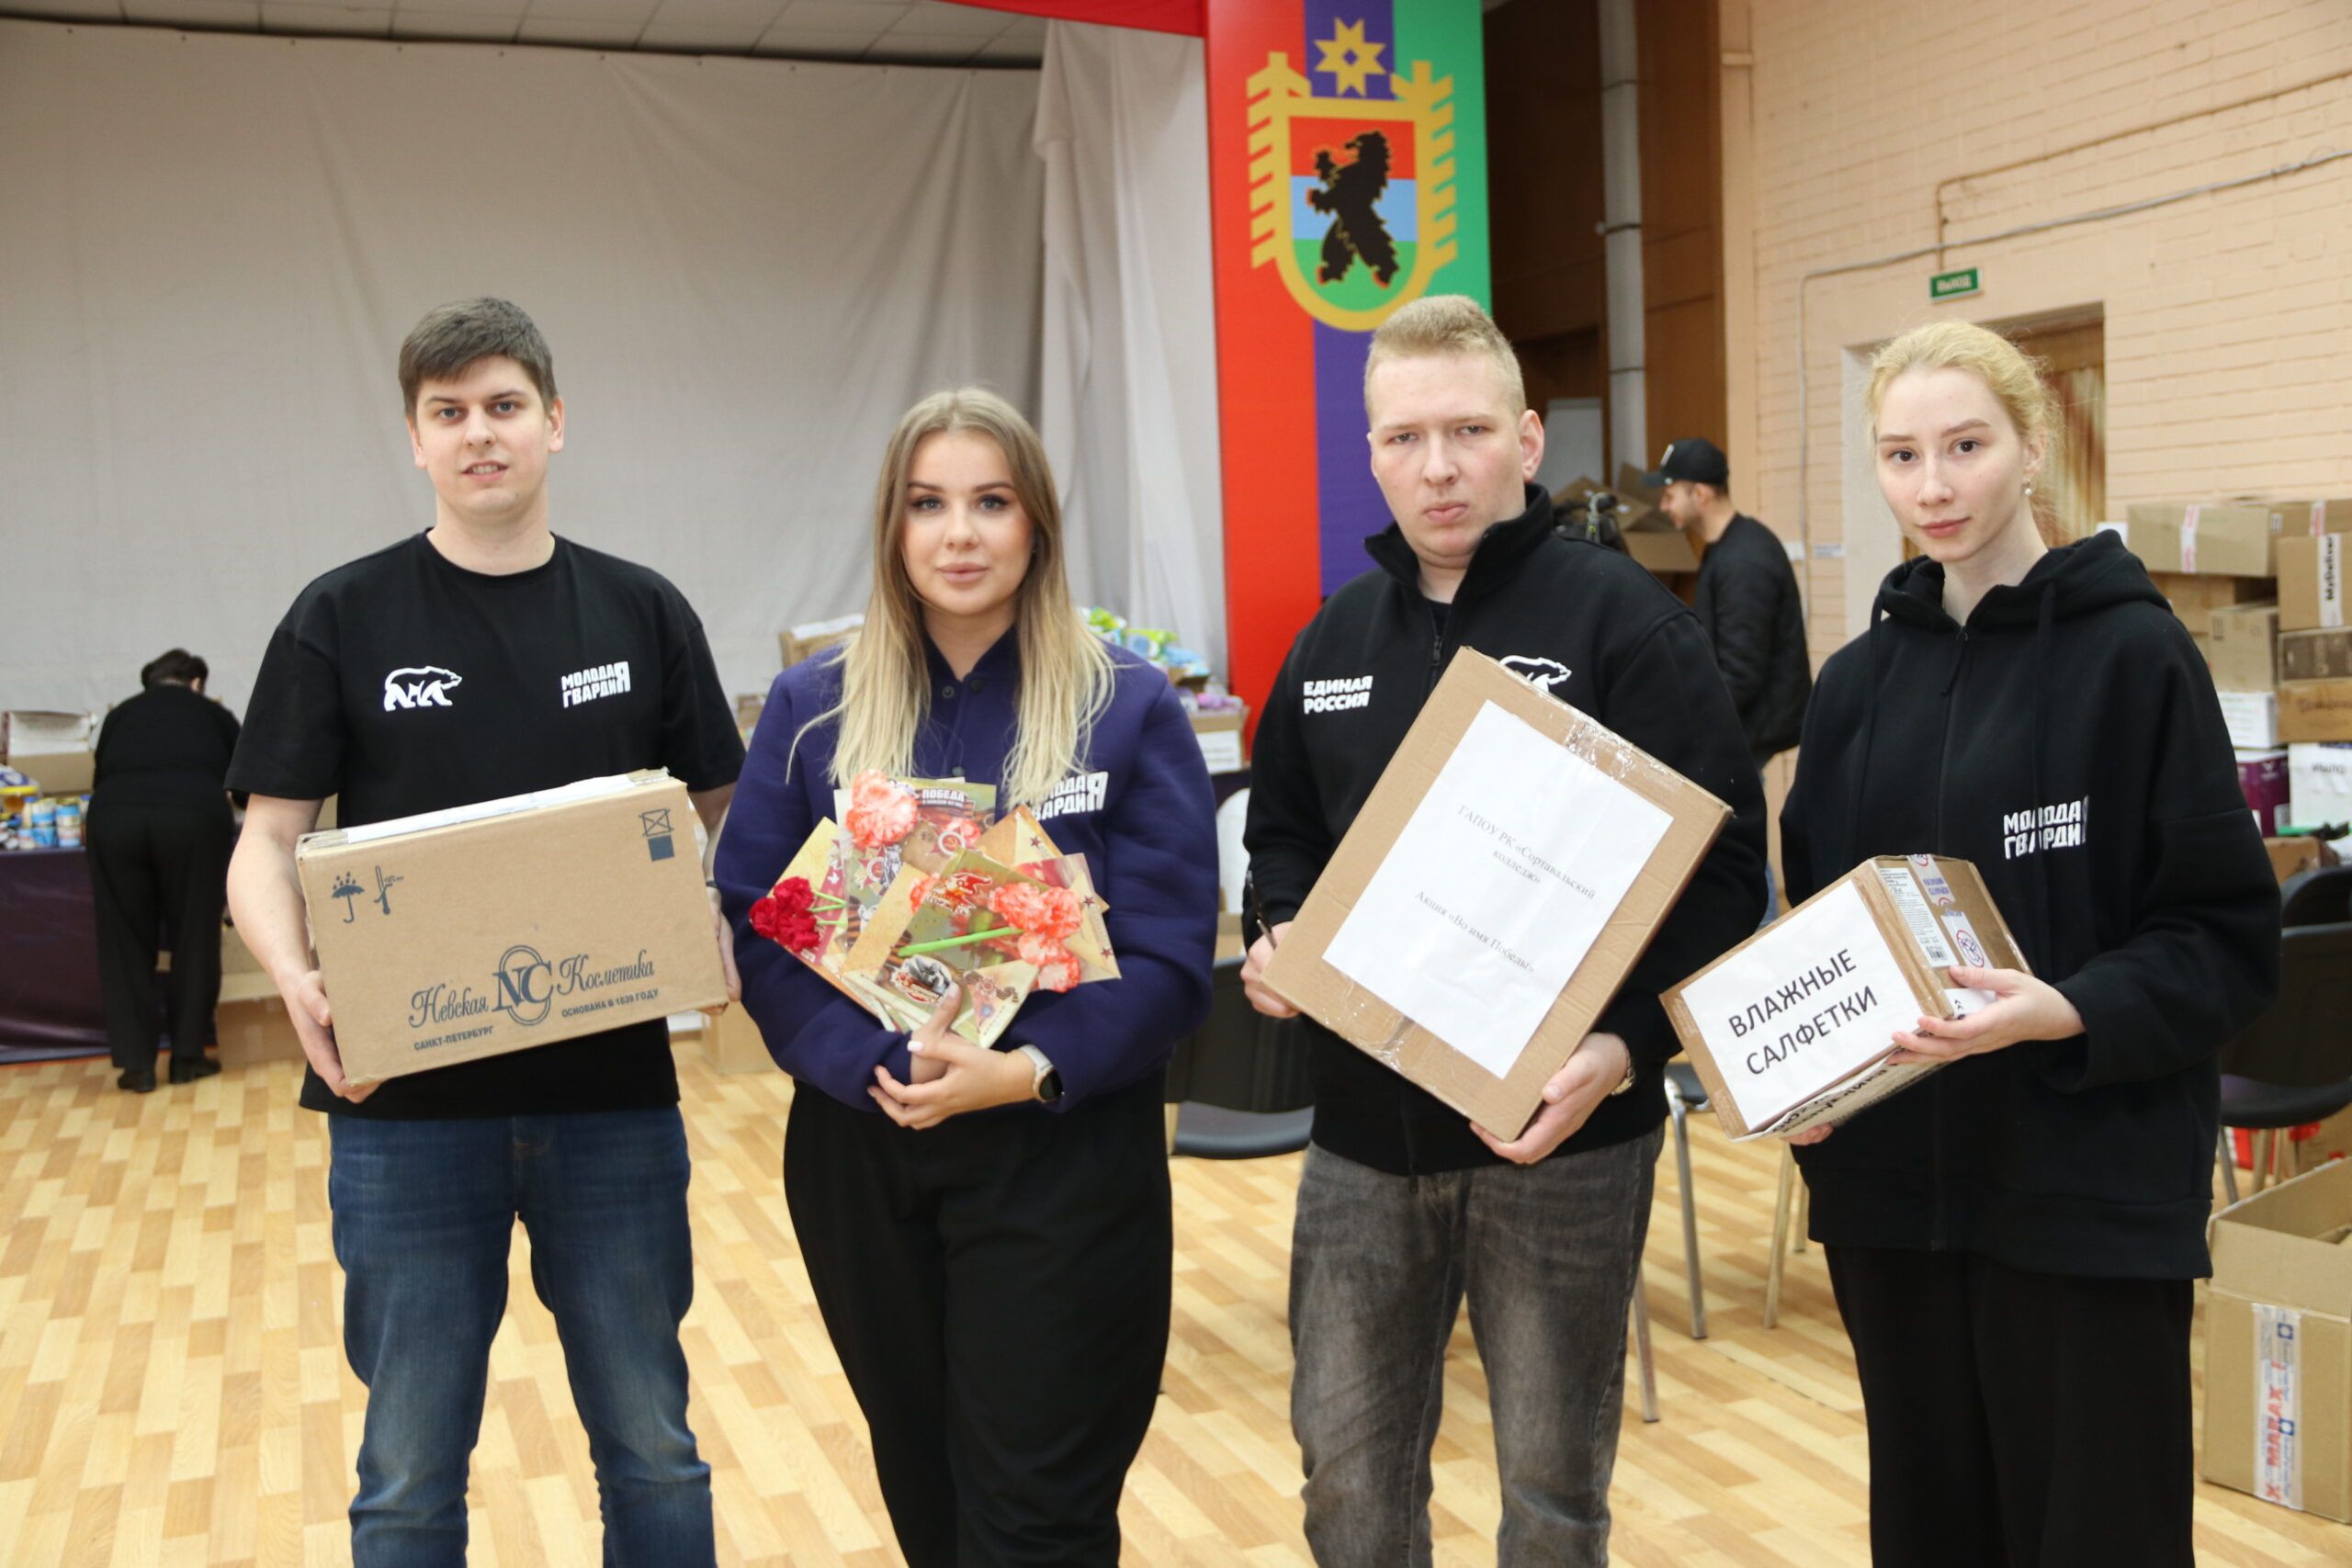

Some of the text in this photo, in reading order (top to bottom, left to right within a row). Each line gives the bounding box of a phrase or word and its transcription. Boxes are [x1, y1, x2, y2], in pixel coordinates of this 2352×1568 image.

[560, 660, 631, 692] МОЛОДАЯ
[562, 671, 631, 708] ГВАРДИЯ
[1303, 675, 1374, 697] ЕДИНАЯ
[1303, 691, 1370, 715] РОССИЯ
[922, 788, 966, 803] ПОБЕДА
[1457, 805, 1499, 835] ГАПОУ
[1498, 831, 1517, 848] РК
[1415, 891, 1448, 917] Акция
[1469, 926, 1490, 945] имя
[408, 983, 489, 1028] Невская
[557, 948, 655, 996] Косметика
[561, 1000, 606, 1018] ОСНОВАНА
[607, 999, 615, 1008] В
[635, 987, 659, 1002] ГОДУ
[1728, 948, 1857, 1038] ВЛАЖНЫЕ
[413, 1025, 493, 1051] САНКТ-ПЕТЕРБУРГ
[1746, 986, 1878, 1075] САЛФЕТКИ
